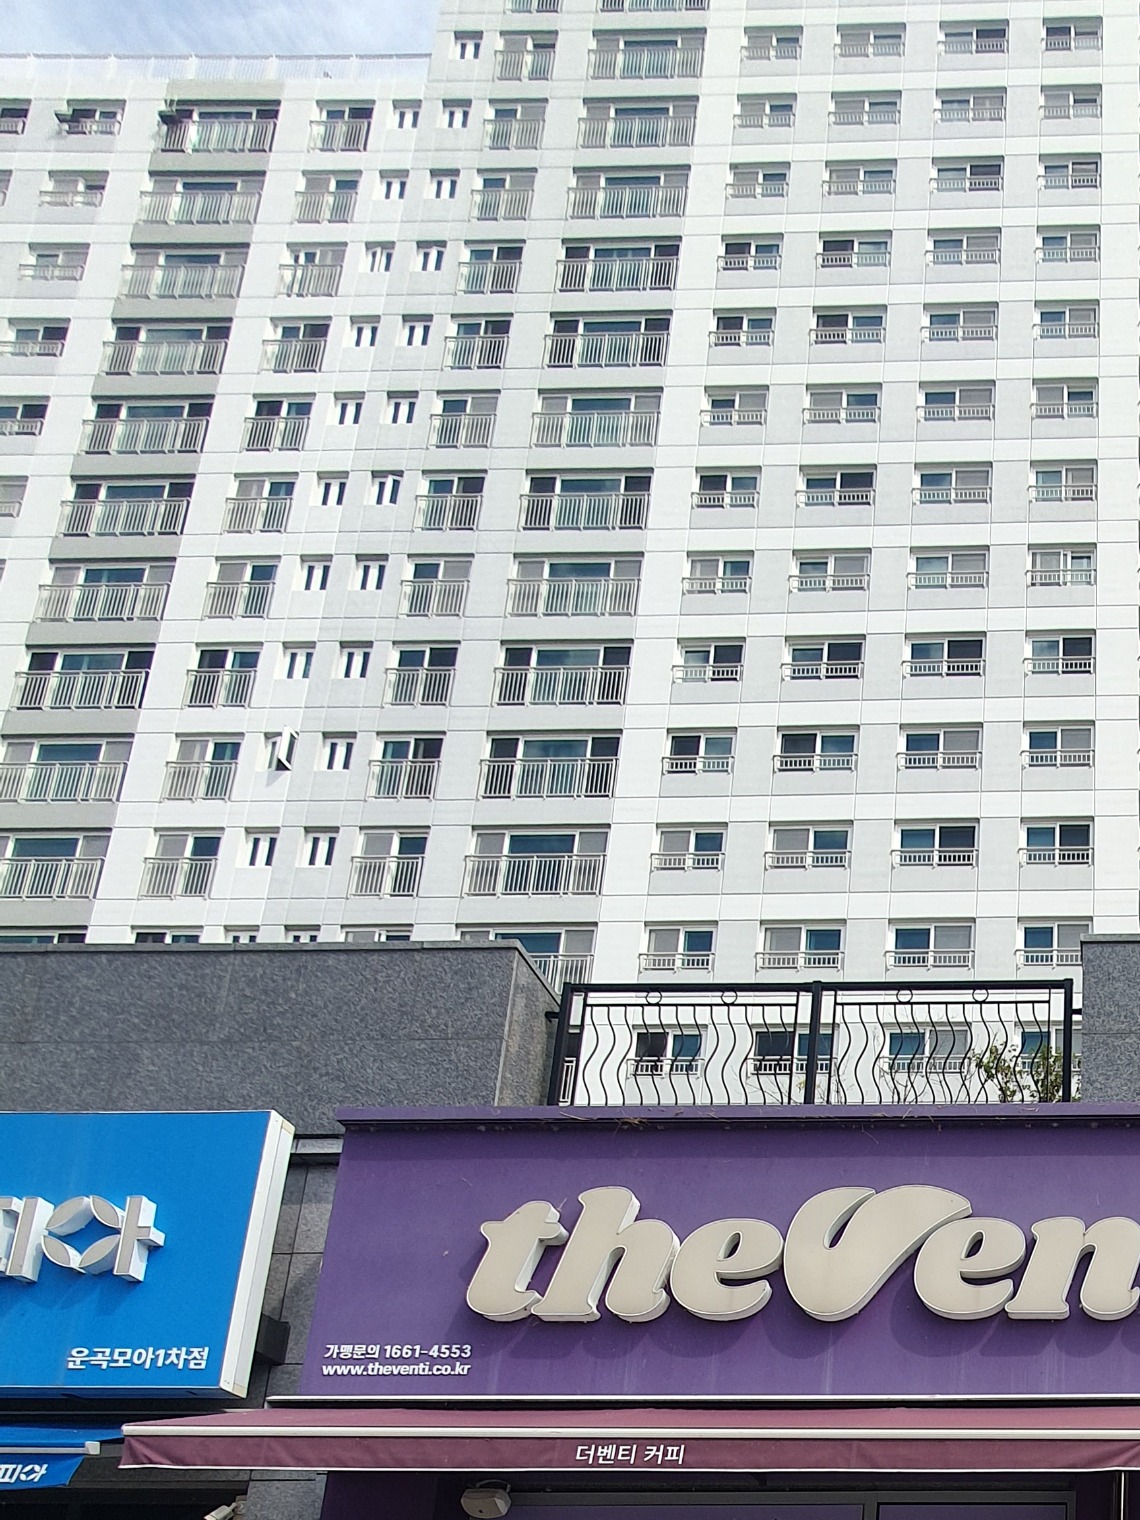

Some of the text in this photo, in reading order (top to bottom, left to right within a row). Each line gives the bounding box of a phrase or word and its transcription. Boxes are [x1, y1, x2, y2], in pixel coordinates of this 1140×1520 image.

[66, 1346, 209, 1369] 운곡모아1차점
[324, 1344, 472, 1360] 가맹문의 1661-4553
[322, 1361, 471, 1377] www.theventi.co.kr
[574, 1445, 685, 1464] 더벤티 커피
